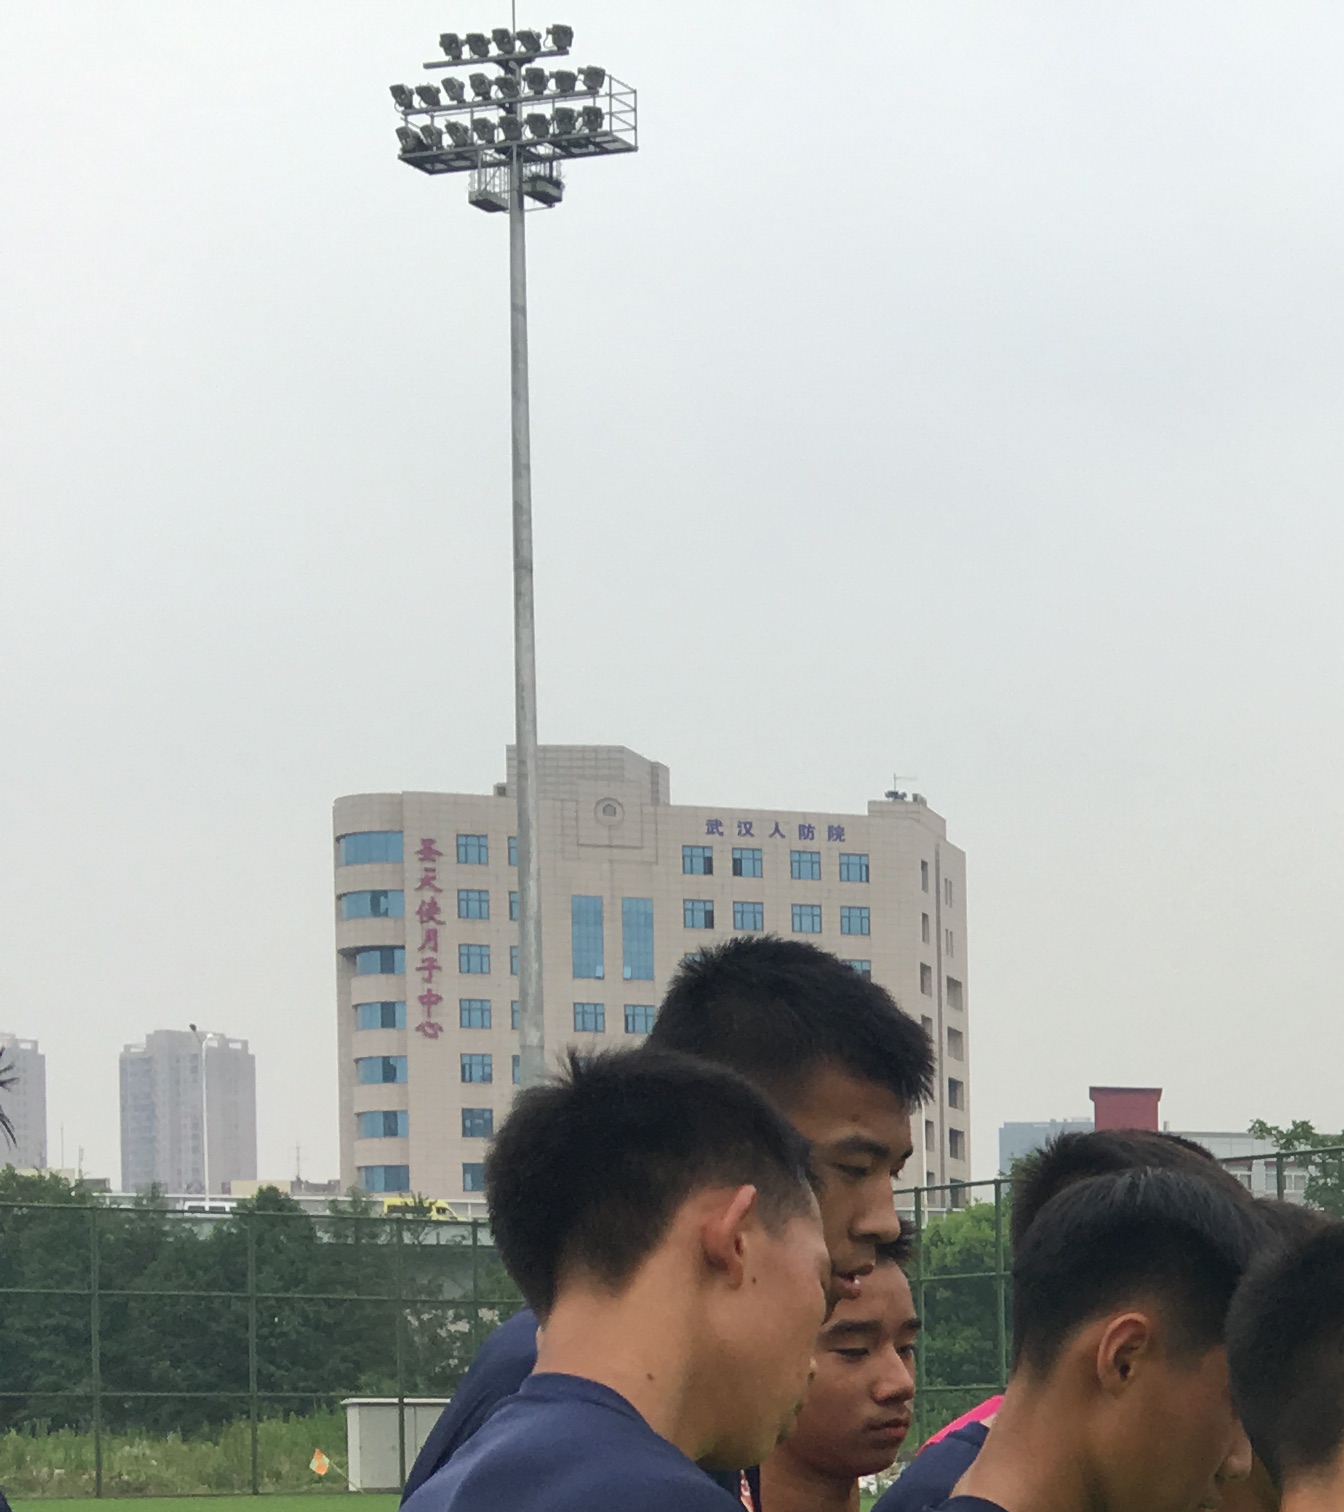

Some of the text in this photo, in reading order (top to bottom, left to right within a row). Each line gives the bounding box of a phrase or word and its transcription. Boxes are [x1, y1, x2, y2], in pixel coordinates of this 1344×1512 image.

[705, 818, 846, 842] 武汉人防院
[414, 838, 446, 1040] 圣天使月子中心
